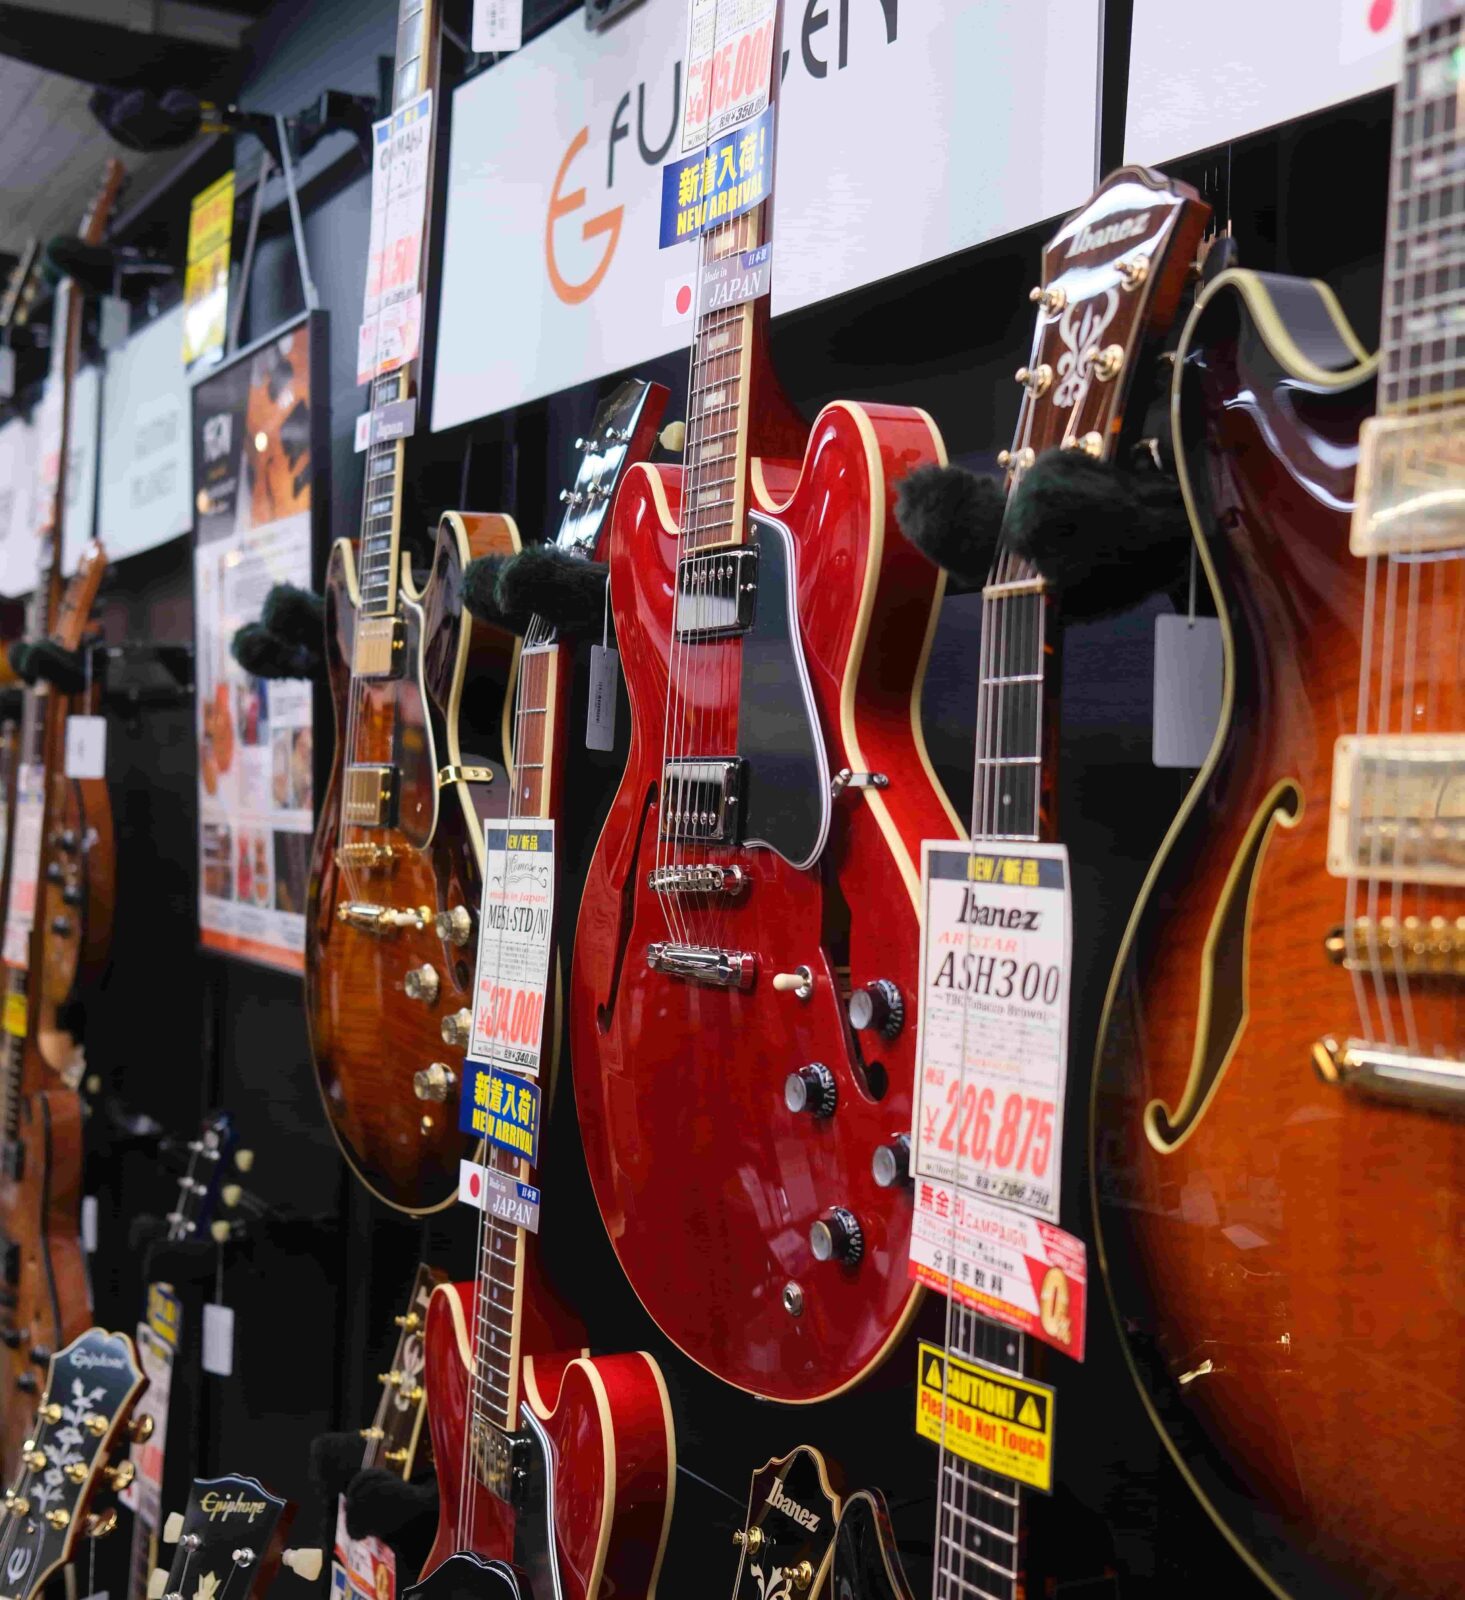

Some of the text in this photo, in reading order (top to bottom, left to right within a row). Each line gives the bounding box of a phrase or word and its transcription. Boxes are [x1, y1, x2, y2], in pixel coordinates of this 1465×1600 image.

[678, 127, 765, 207] 新着入荷!
[676, 171, 763, 236] NEW ARRIVAL
[1064, 211, 1151, 259] Ibanez
[709, 270, 763, 308] JAPAN
[955, 886, 1042, 932] Ibanez
[932, 951, 1060, 1005] ASH300
[474, 1070, 536, 1131] 新着入荷!
[472, 1107, 534, 1157] NEW ARRIVAL
[922, 1078, 1055, 1179] ¥226,875
[492, 1193, 533, 1225] JAPAN
[946, 1364, 1017, 1420] CAUTION!
[921, 1390, 954, 1425] Please
[957, 1408, 971, 1433] Do
[976, 1416, 996, 1444] Not
[1001, 1425, 1046, 1462] Touch
[200, 1491, 267, 1524] Epiphone
[764, 1477, 821, 1533] Ibanez
